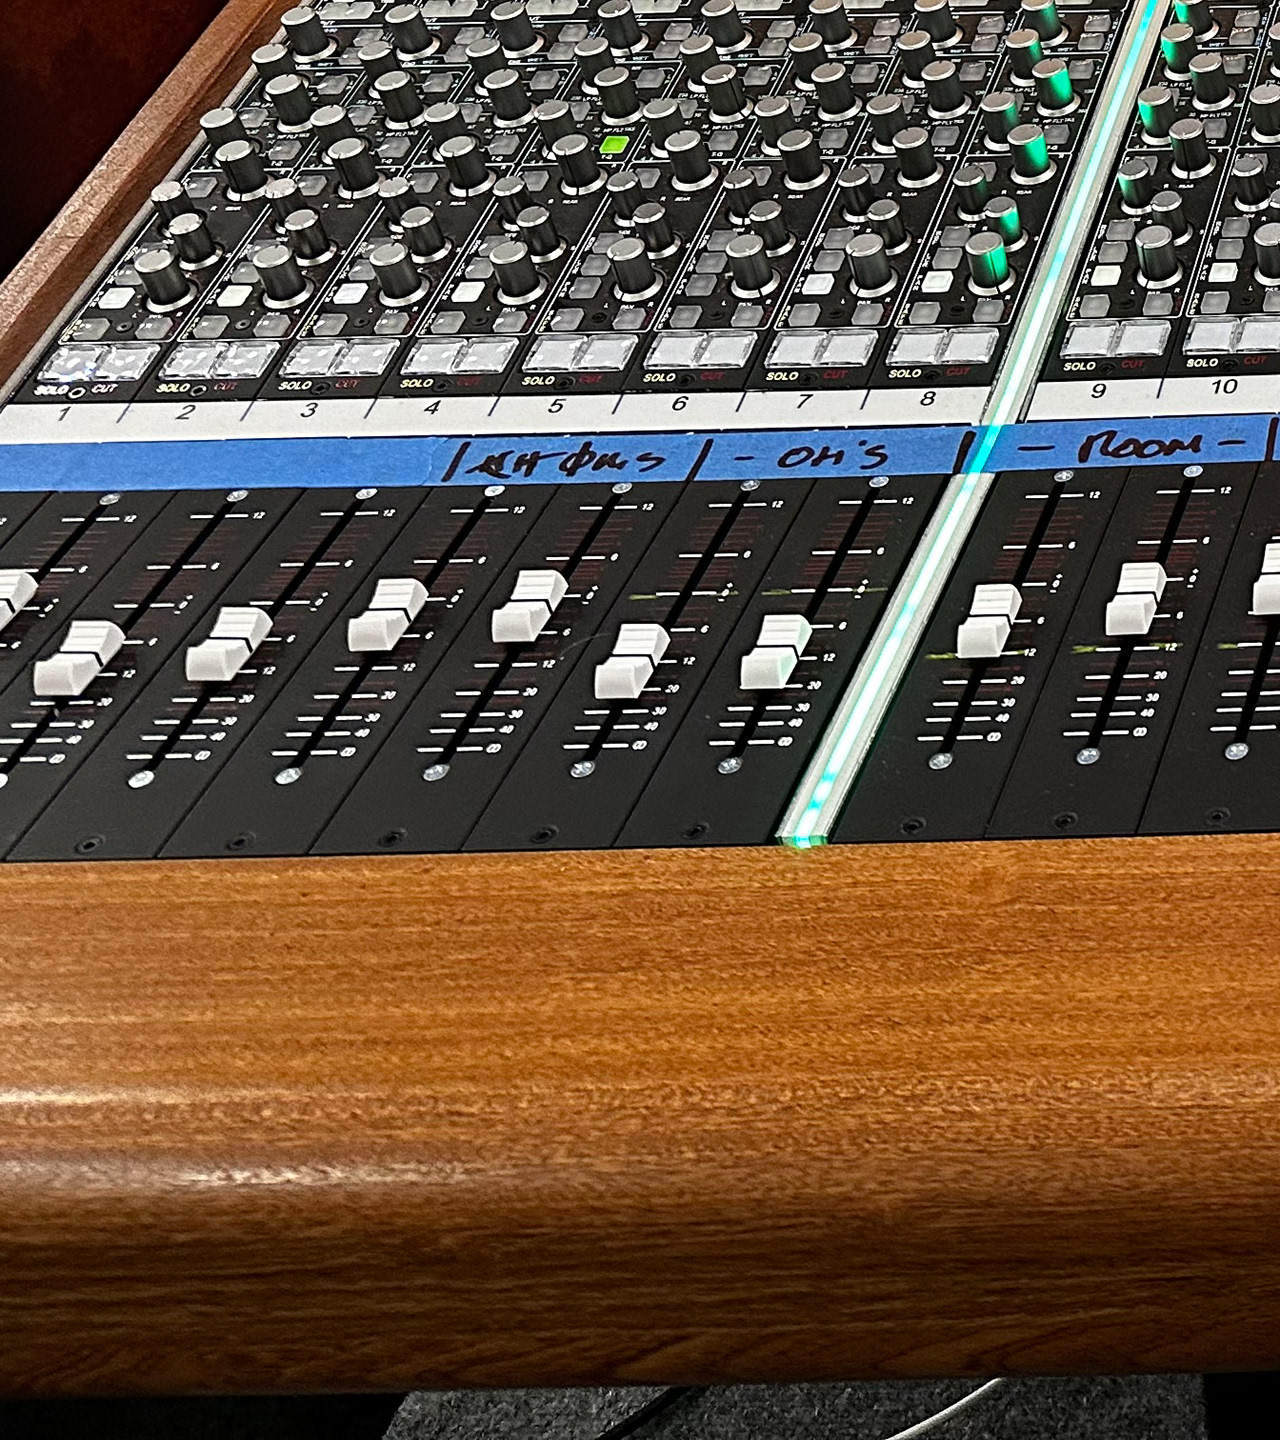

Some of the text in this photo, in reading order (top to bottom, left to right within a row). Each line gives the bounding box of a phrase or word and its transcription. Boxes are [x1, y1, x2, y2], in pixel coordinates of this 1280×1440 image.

[279, 380, 312, 391] SOLO
[1090, 383, 1107, 399] 9
[1212, 378, 1238, 394] 10
[547, 398, 566, 414] 5
[671, 395, 689, 411] 6
[796, 393, 814, 409] 7
[919, 390, 937, 407] 8
[59, 406, 71, 421] 1
[175, 404, 196, 420] 2
[300, 402, 319, 418] 3
[423, 400, 442, 415] 4
